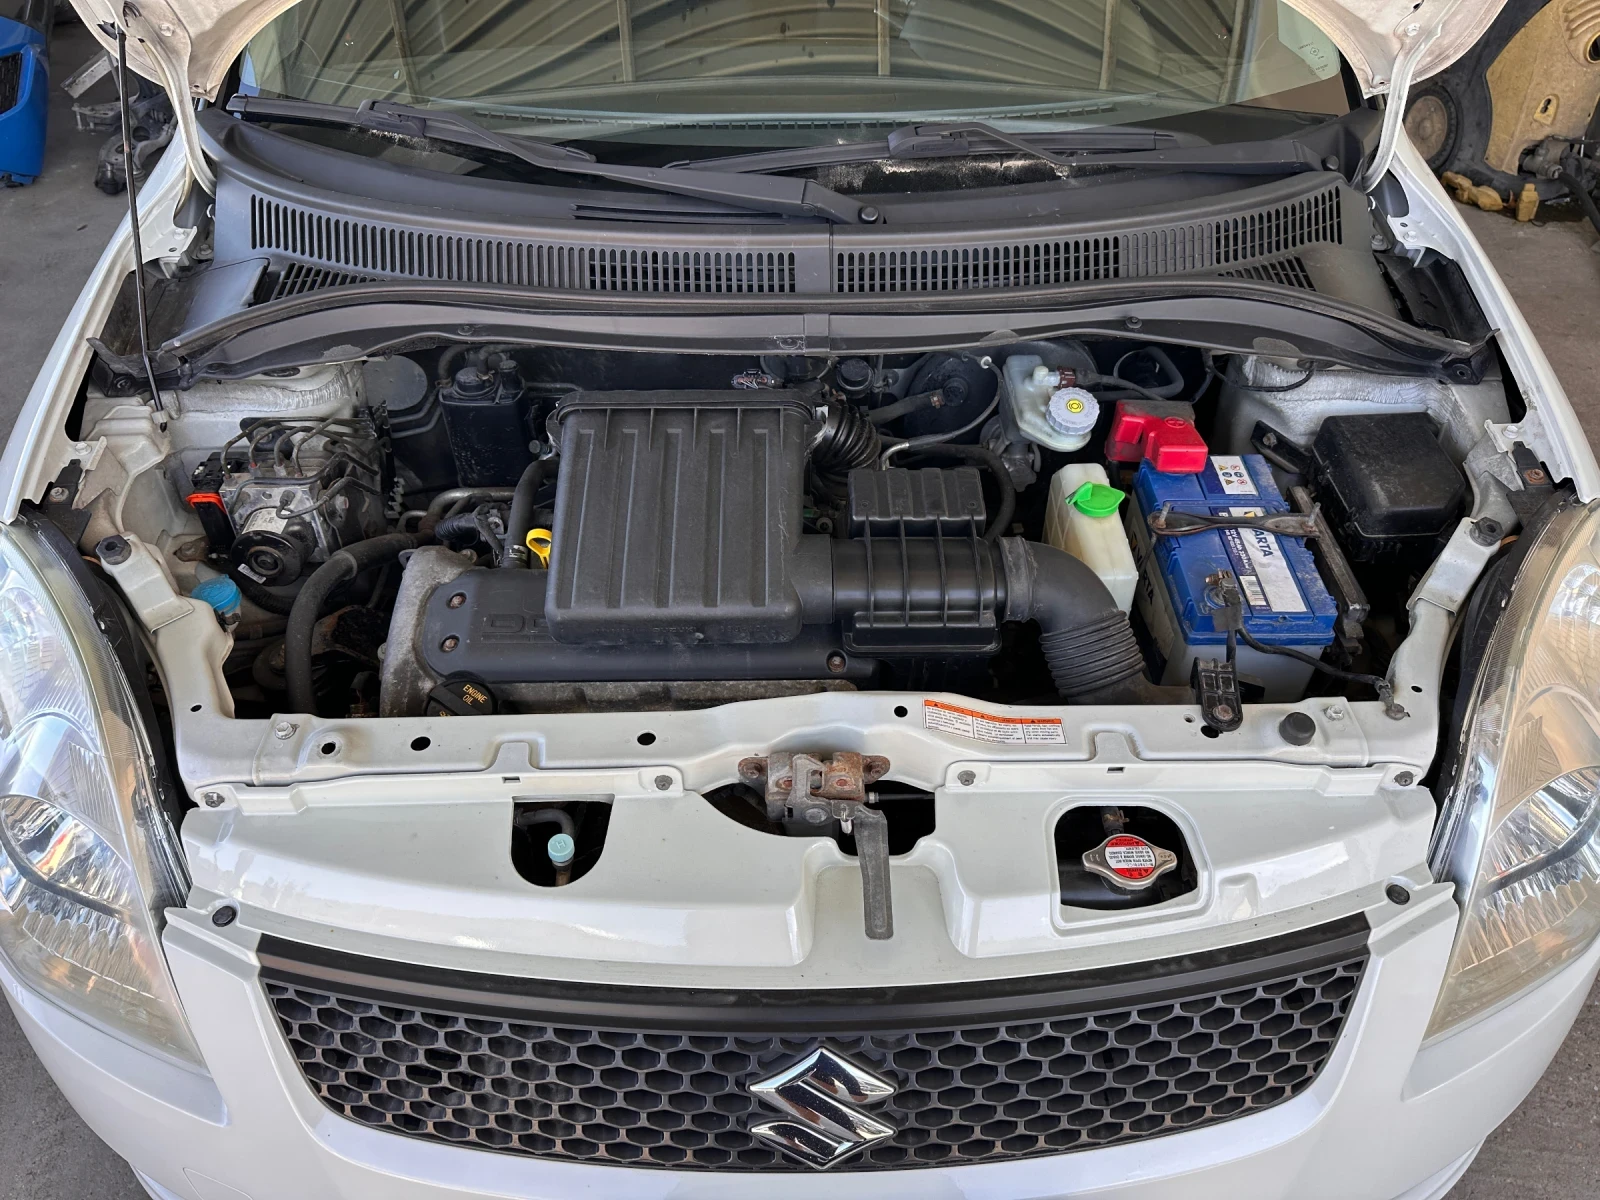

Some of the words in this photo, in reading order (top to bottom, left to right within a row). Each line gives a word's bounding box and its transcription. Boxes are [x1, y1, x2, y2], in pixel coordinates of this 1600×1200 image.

[1252, 530, 1274, 558] ARTA
[462, 684, 488, 704] ENGINE
[462, 693, 473, 706] OIL
